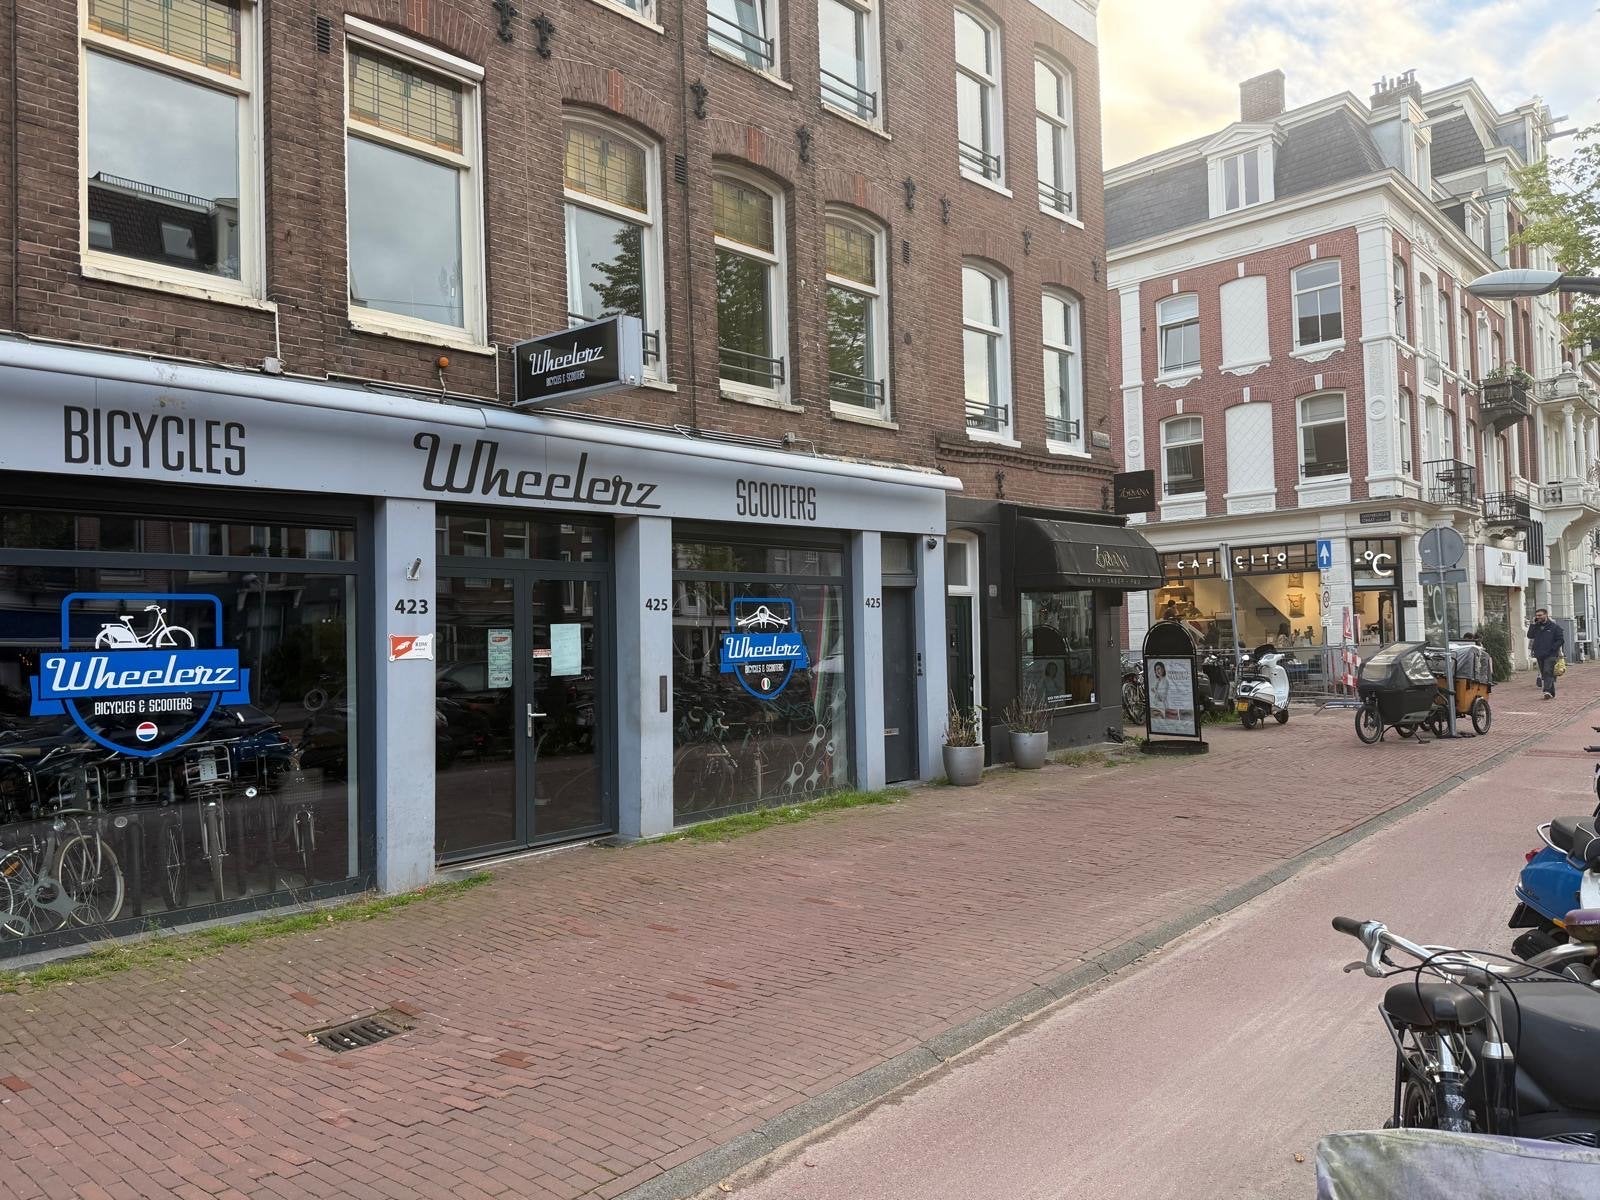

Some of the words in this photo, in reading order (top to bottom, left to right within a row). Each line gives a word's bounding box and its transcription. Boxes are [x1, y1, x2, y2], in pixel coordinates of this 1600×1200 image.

[529, 341, 605, 376] Wheelerz
[64, 405, 246, 476] BICYCLES
[413, 432, 662, 510] Wheelerz
[736, 478, 817, 521] SCOOTERS
[1177, 558, 1213, 569] CAF
[1235, 553, 1287, 565] CITO
[394, 599, 429, 615] 423
[645, 598, 668, 611] 425
[865, 597, 881, 609] 425
[725, 635, 802, 659] Wheelerz
[46, 654, 237, 692] Wheelerz
[94, 700, 136, 715] BICYCLES
[138, 699, 146, 713] &
[148, 697, 193, 712] SCOOTERS
